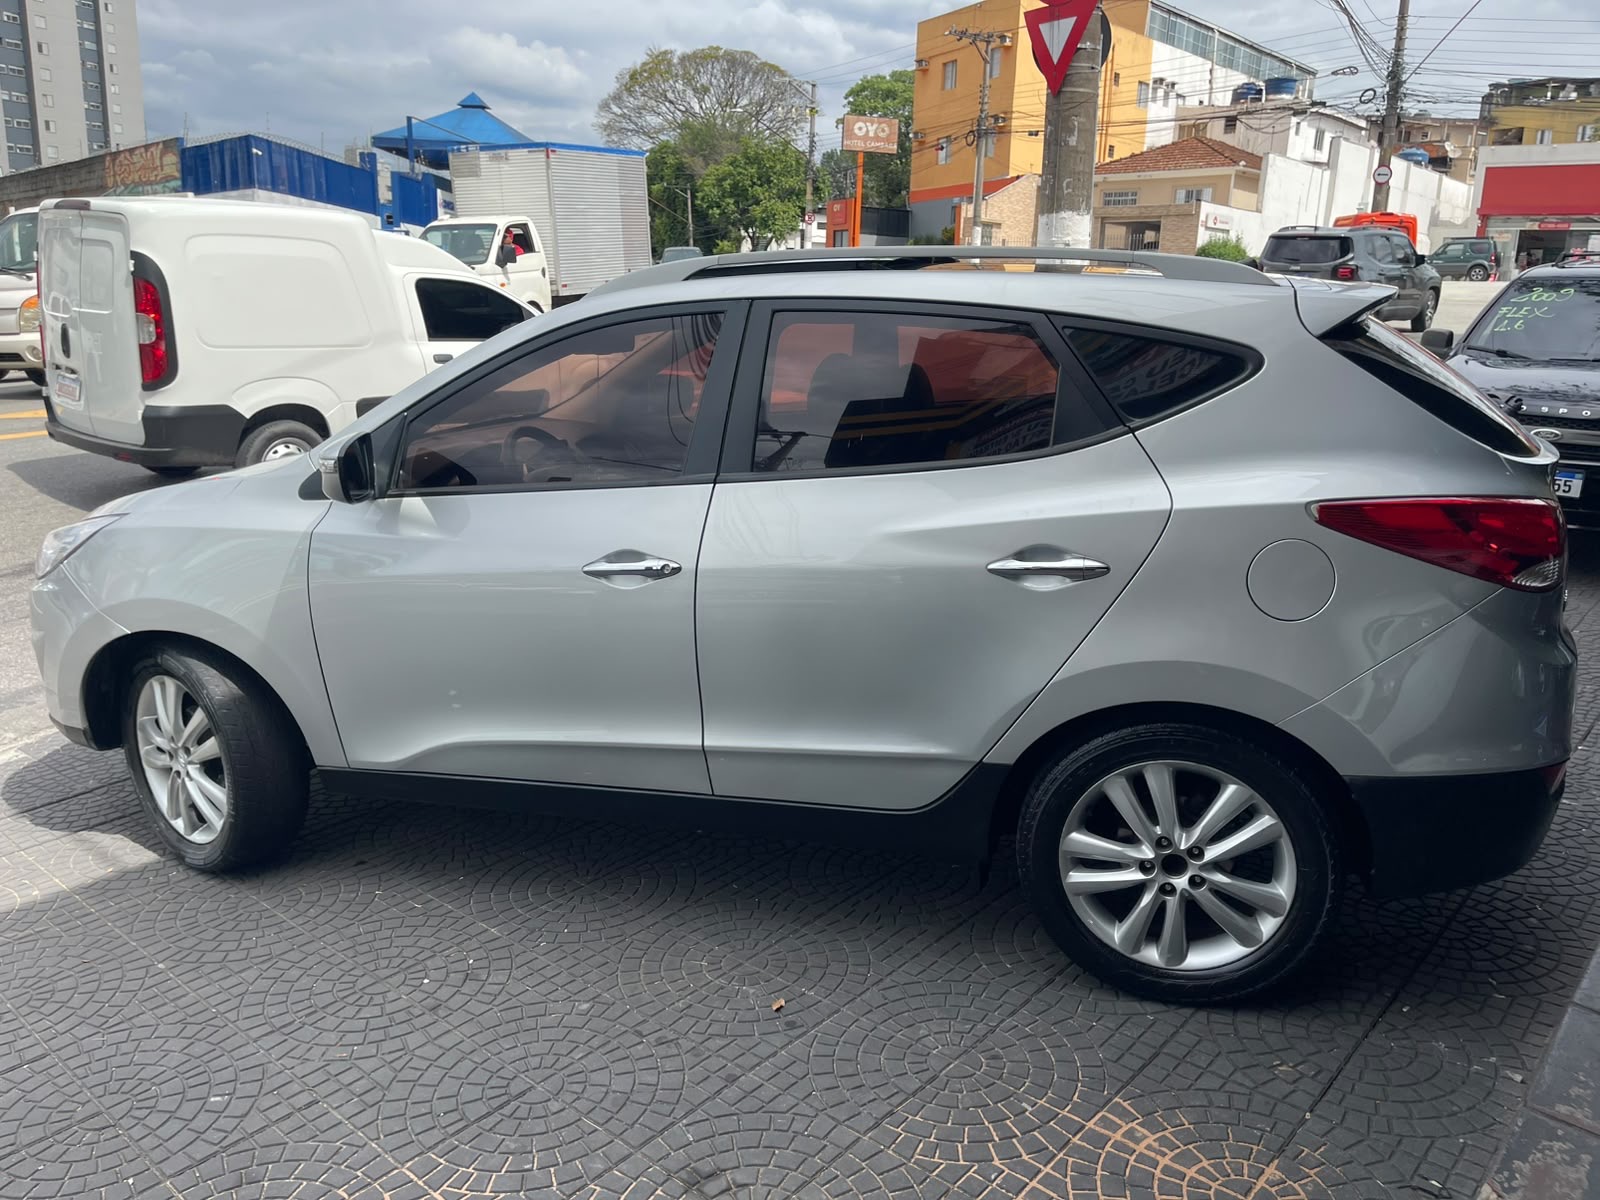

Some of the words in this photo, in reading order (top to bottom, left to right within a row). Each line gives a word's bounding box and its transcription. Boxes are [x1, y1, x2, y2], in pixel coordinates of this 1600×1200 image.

[853, 121, 890, 138] OYO
[844, 139, 866, 147] HOTEL
[1510, 287, 1574, 302] 2009
[1498, 307, 1556, 318] FLEX
[1494, 320, 1525, 331] 1.6
